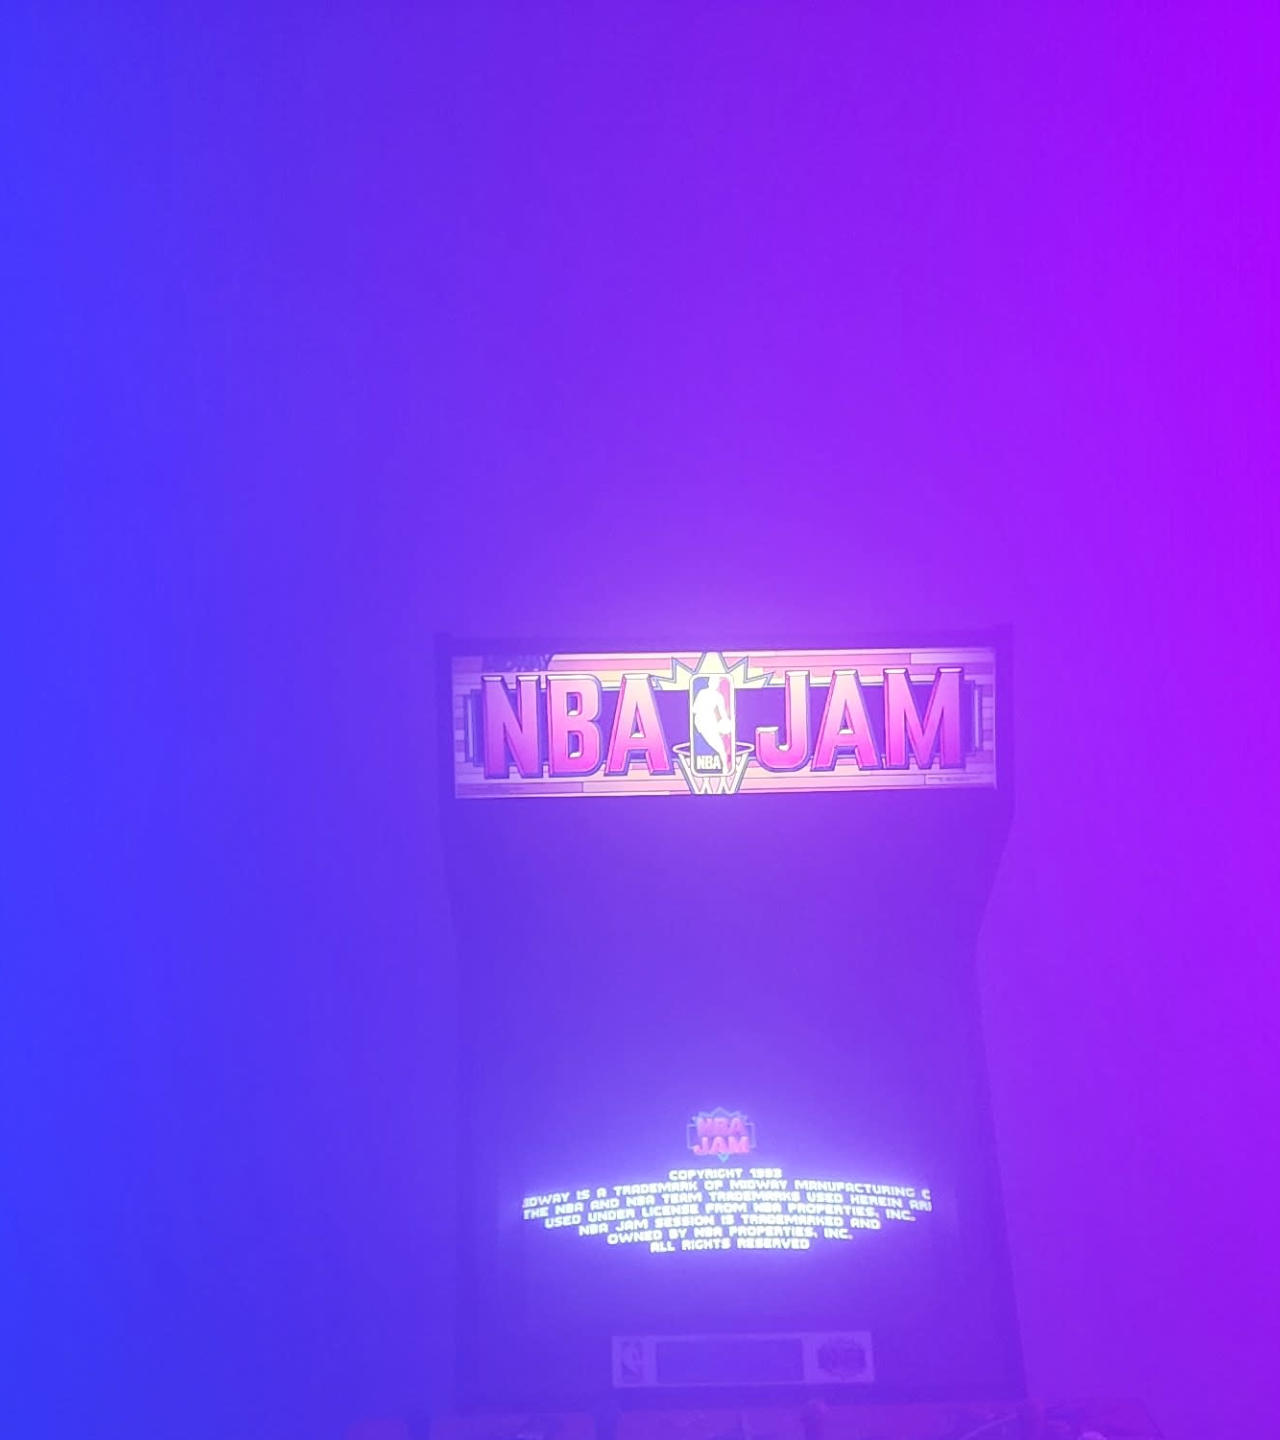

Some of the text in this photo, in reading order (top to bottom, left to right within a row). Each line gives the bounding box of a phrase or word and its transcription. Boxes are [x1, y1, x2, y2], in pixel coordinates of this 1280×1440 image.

[481, 667, 968, 778] NBA JAM
[697, 754, 720, 770] NBA
[696, 1117, 747, 1137] NBA
[692, 1135, 750, 1155] JAM
[669, 1168, 743, 1181] COPYRIGHT
[576, 1189, 591, 1201] IS
[596, 1187, 608, 1198] A
[613, 1181, 699, 1197] TRADEMARK
[704, 1180, 723, 1191] OF
[730, 1180, 788, 1191] MIDWAY
[794, 1180, 916, 1198] MANUFACTURING
[523, 1207, 549, 1220] THE
[555, 1203, 584, 1216] NBA
[590, 1199, 620, 1212] AND
[626, 1195, 656, 1208] NBA
[661, 1192, 702, 1204] TEAM
[709, 1191, 800, 1202] TRADEMARKS
[806, 1191, 843, 1203] USED
[850, 1194, 904, 1209] HEREIN
[544, 1215, 582, 1229] USED
[587, 1208, 636, 1223] UNDER
[642, 1203, 700, 1218] LICENSE
[705, 1203, 748, 1214] FROM
[886, 1209, 916, 1222] INC.
[578, 1214, 881, 1236] NBA JAM SESSION IS TRADEMARKED AND
[607, 1230, 663, 1245] OWNED
[669, 1228, 688, 1240] BY
[824, 1228, 854, 1241] INC.
[650, 1237, 810, 1254] ALL RIGHTS RESERVED
